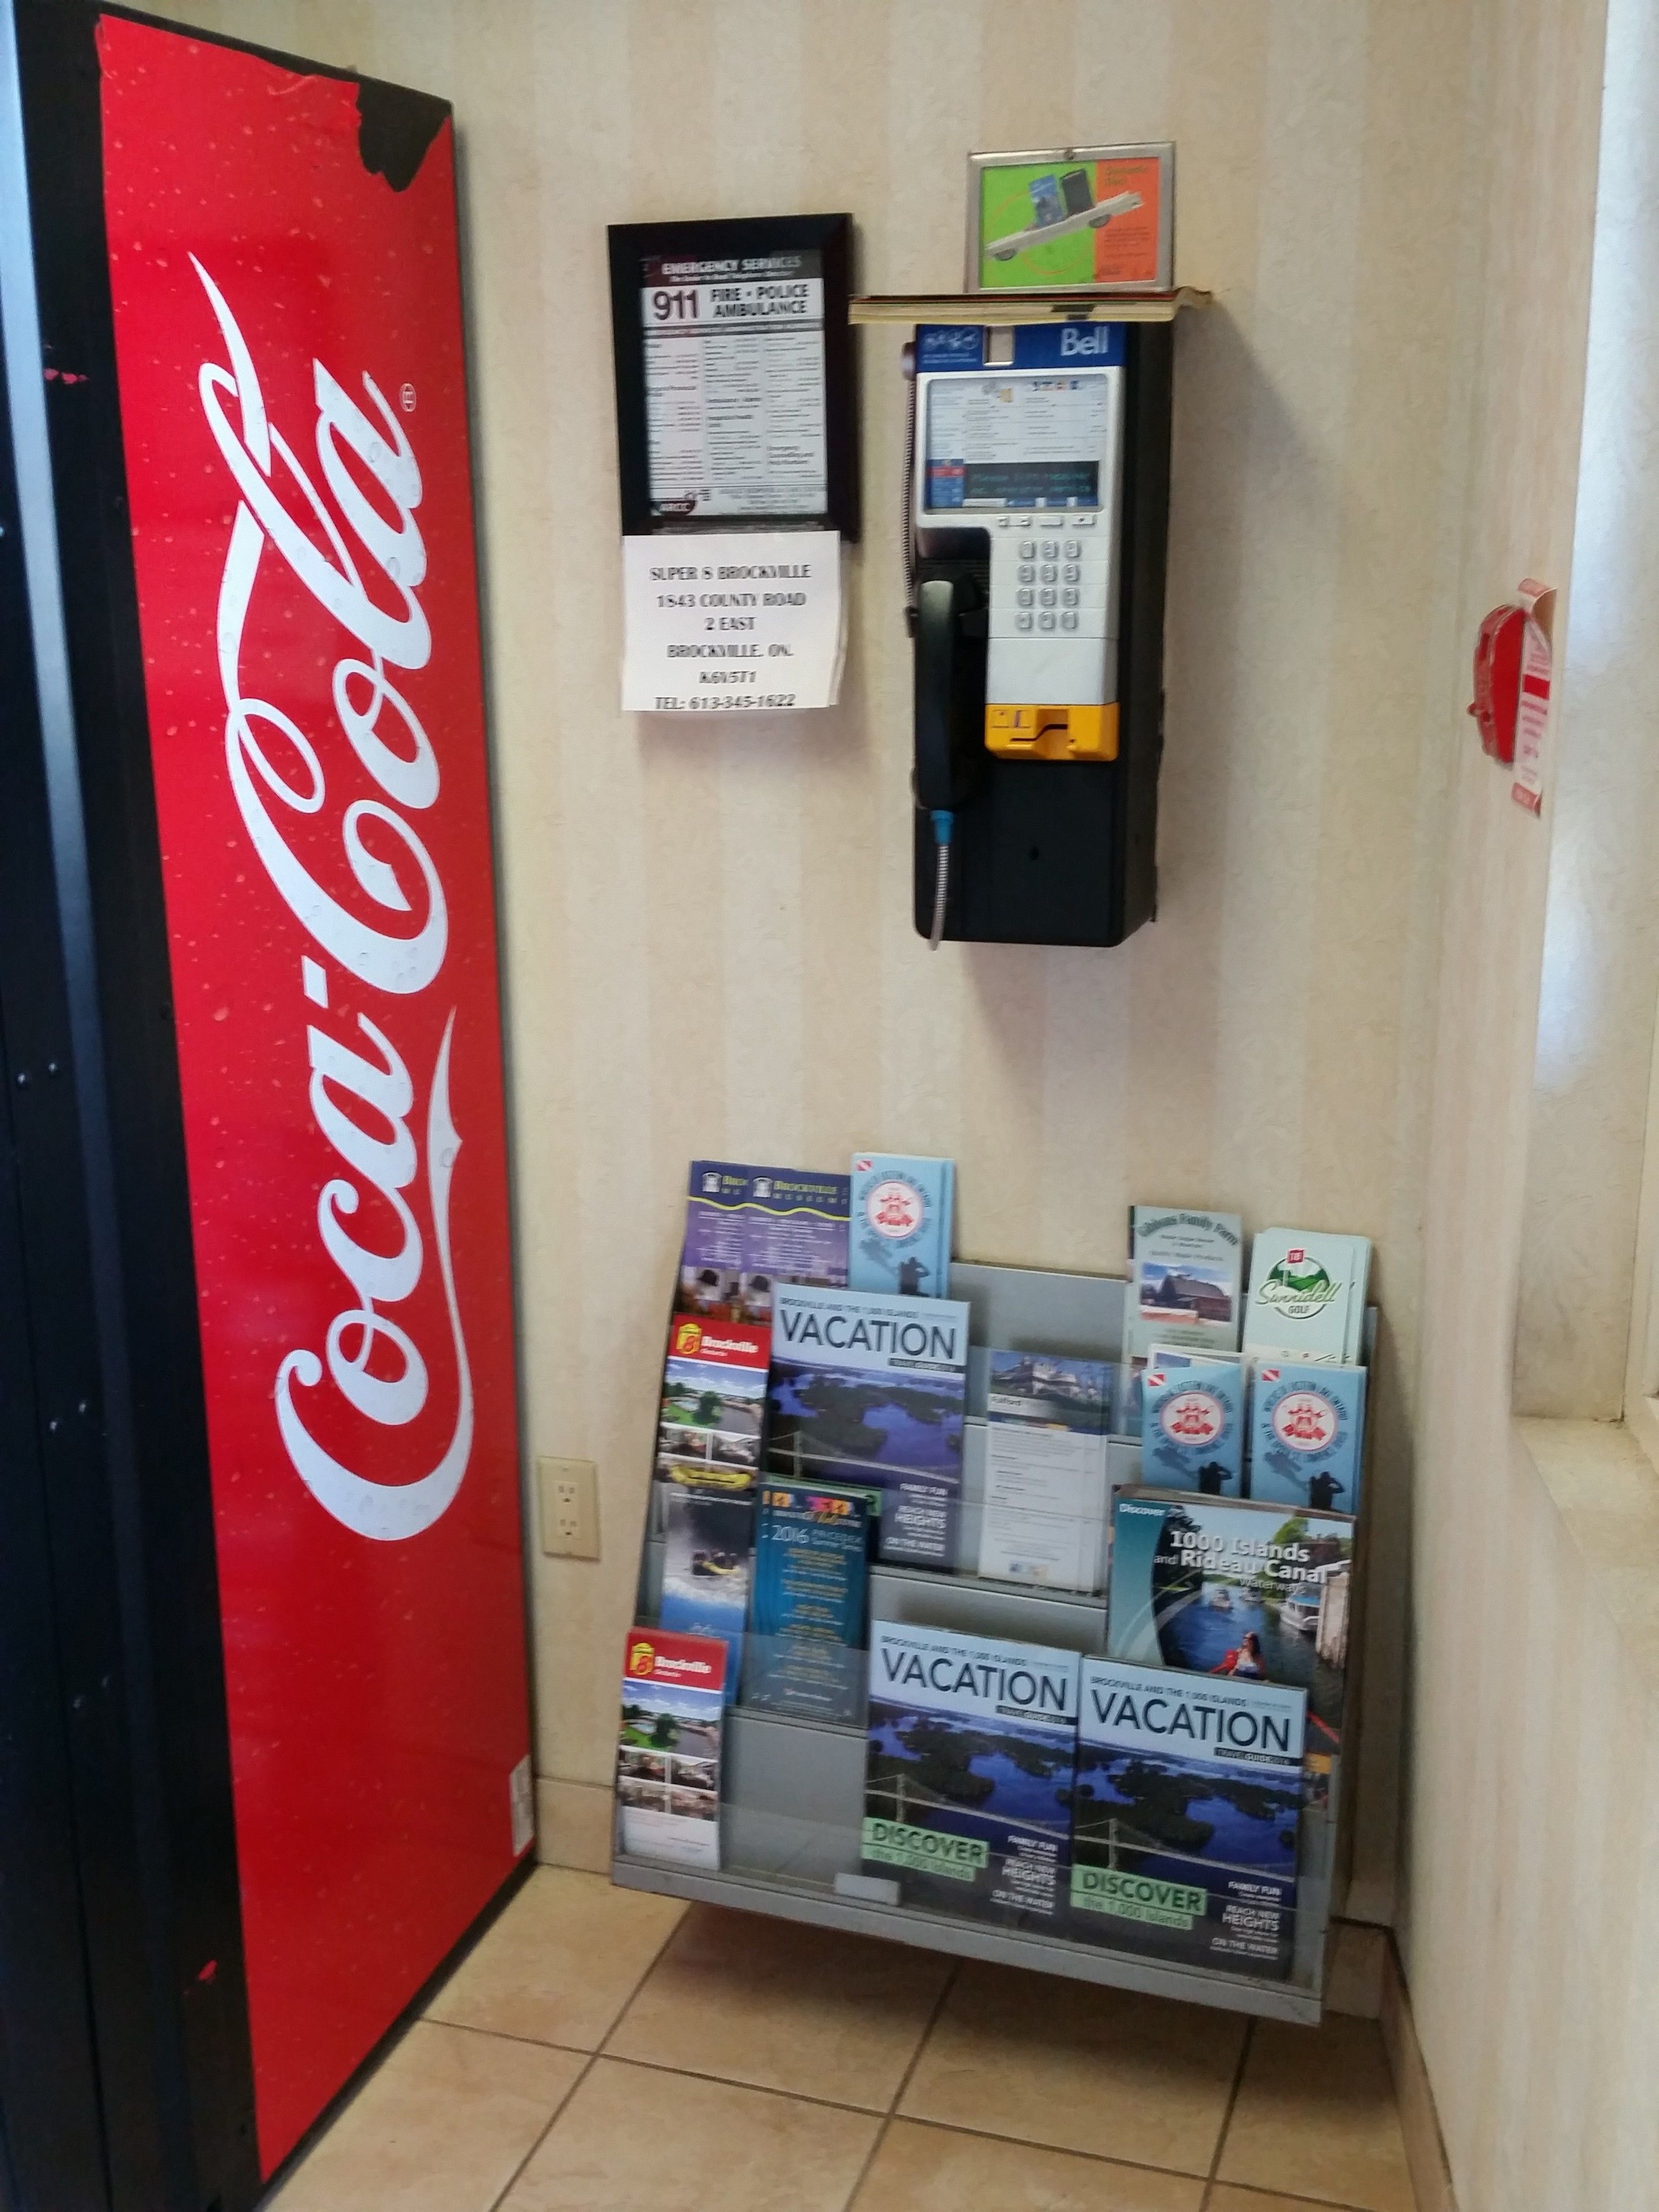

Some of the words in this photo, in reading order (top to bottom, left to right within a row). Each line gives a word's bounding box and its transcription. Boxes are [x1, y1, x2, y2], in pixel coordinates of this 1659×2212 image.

[662, 259, 738, 275] EMERGENCY
[741, 256, 802, 271] SERVICES
[653, 289, 699, 320] 911
[710, 288, 742, 302] FIRE
[756, 284, 809, 299] POLICE
[713, 300, 808, 317] AMBULANCE
[1060, 326, 1110, 356] Bell
[649, 567, 698, 581] SUPER
[717, 565, 812, 579] BROCKVILLE
[699, 593, 758, 607] COUNTY
[762, 592, 807, 606] ROAD
[704, 617, 715, 630] 2
[719, 616, 757, 631] EAST
[654, 696, 686, 710] TEL:
[188, 252, 474, 1541] Coca-Cola
[1213, 1222, 1238, 1247] Farm
[1287, 1305, 1310, 1314] GOLF
[780, 1309, 956, 1359] VACATION
[1119, 1503, 1166, 1517] Discover
[771, 1524, 810, 1544] 2016
[1170, 1530, 1224, 1553] 1000
[1230, 1537, 1310, 1563] Islands
[1153, 1555, 1179, 1565] and
[1181, 1548, 1264, 1574] Rideau
[1265, 1559, 1327, 1584] Canal
[881, 1647, 1067, 1711] VACATION
[1090, 1676, 1142, 1691] BROCKVILLE
[1143, 1685, 1164, 1695] AND
[1165, 1687, 1183, 1698] THE
[1212, 1692, 1247, 1707] ISLANDS
[1090, 1688, 1290, 1752] VACATION
[873, 1822, 983, 1862] DISCOVER
[1002, 1866, 1056, 1886] HEIGHTS
[1082, 1872, 1202, 1912] DISCOVER
[1260, 1885, 1282, 1896] FUN
[1222, 1912, 1279, 1931] HEIGHTS
